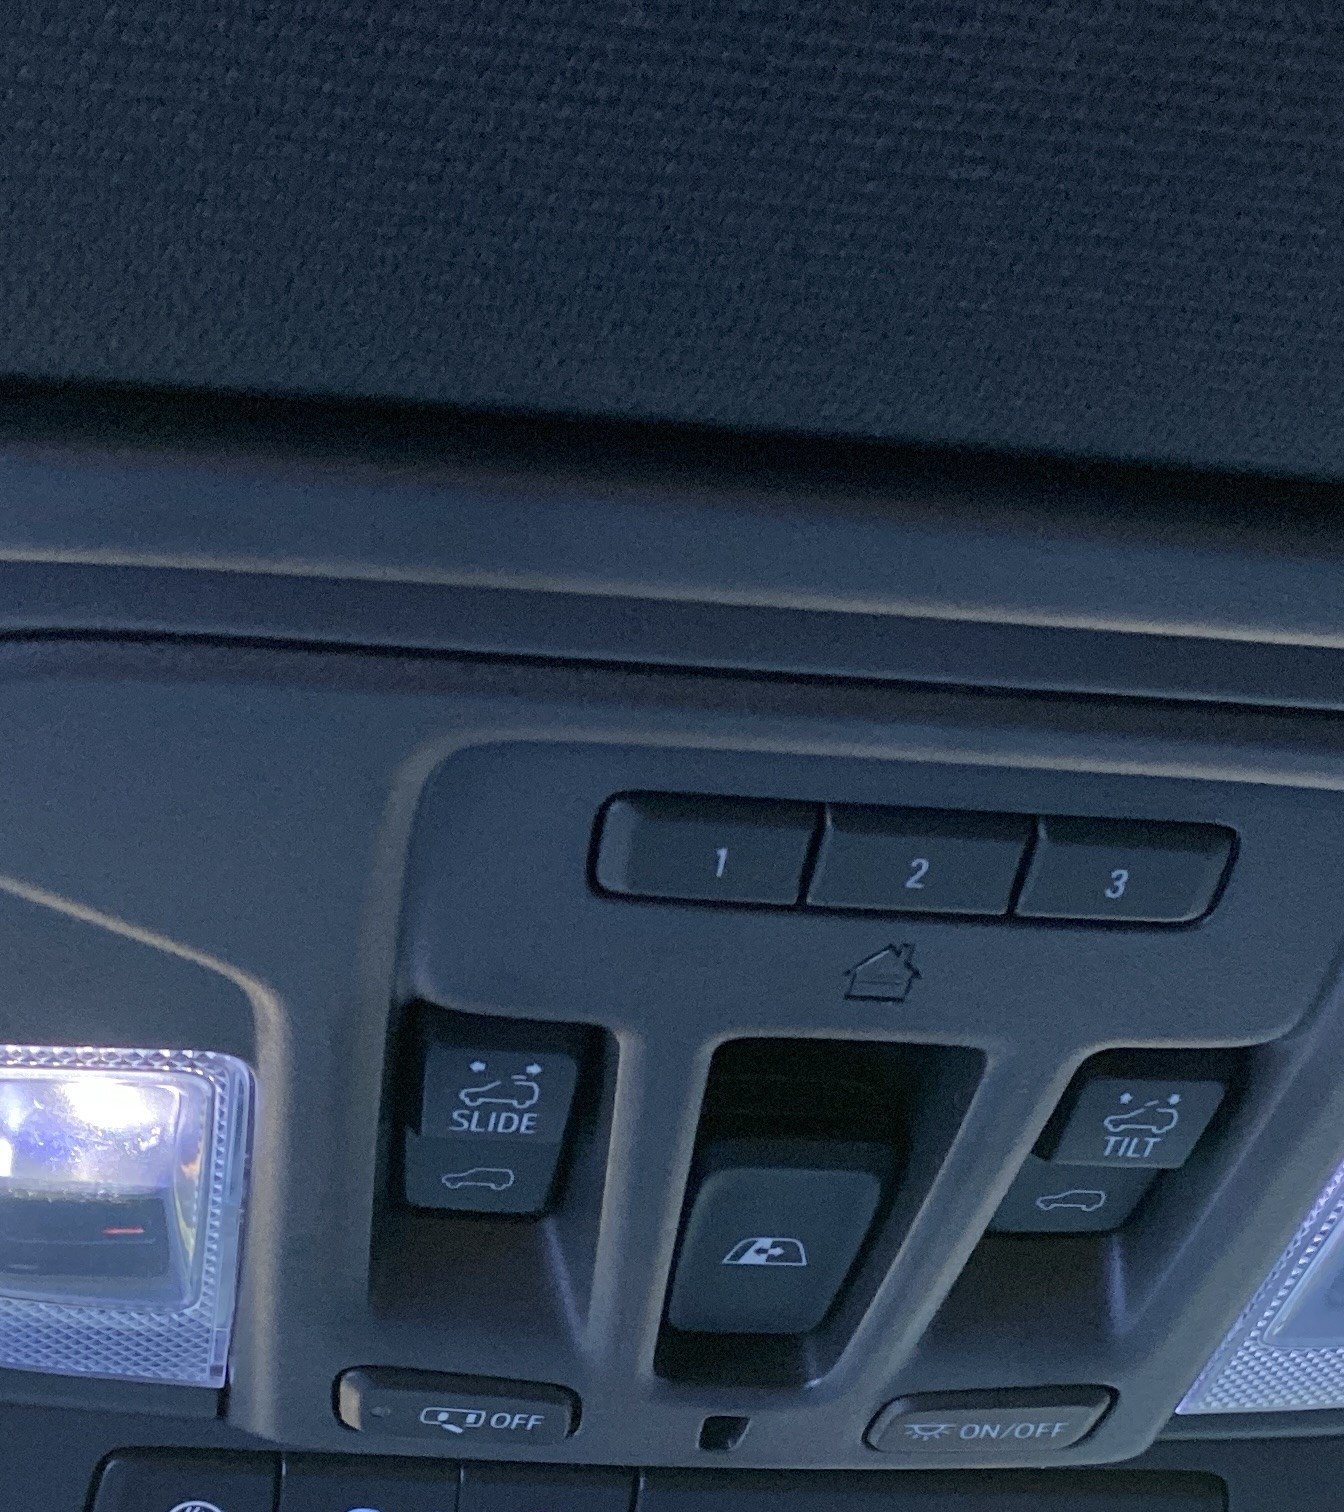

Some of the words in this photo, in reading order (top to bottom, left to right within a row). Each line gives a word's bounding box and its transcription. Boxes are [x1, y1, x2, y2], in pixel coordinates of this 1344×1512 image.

[715, 847, 728, 878] 1
[905, 858, 930, 889] 2
[1104, 869, 1130, 899] 3
[448, 1109, 539, 1134] SLIDE
[1103, 1136, 1162, 1158] TILT
[490, 1412, 545, 1431] OFF
[959, 1422, 1069, 1440] ON/OFF
